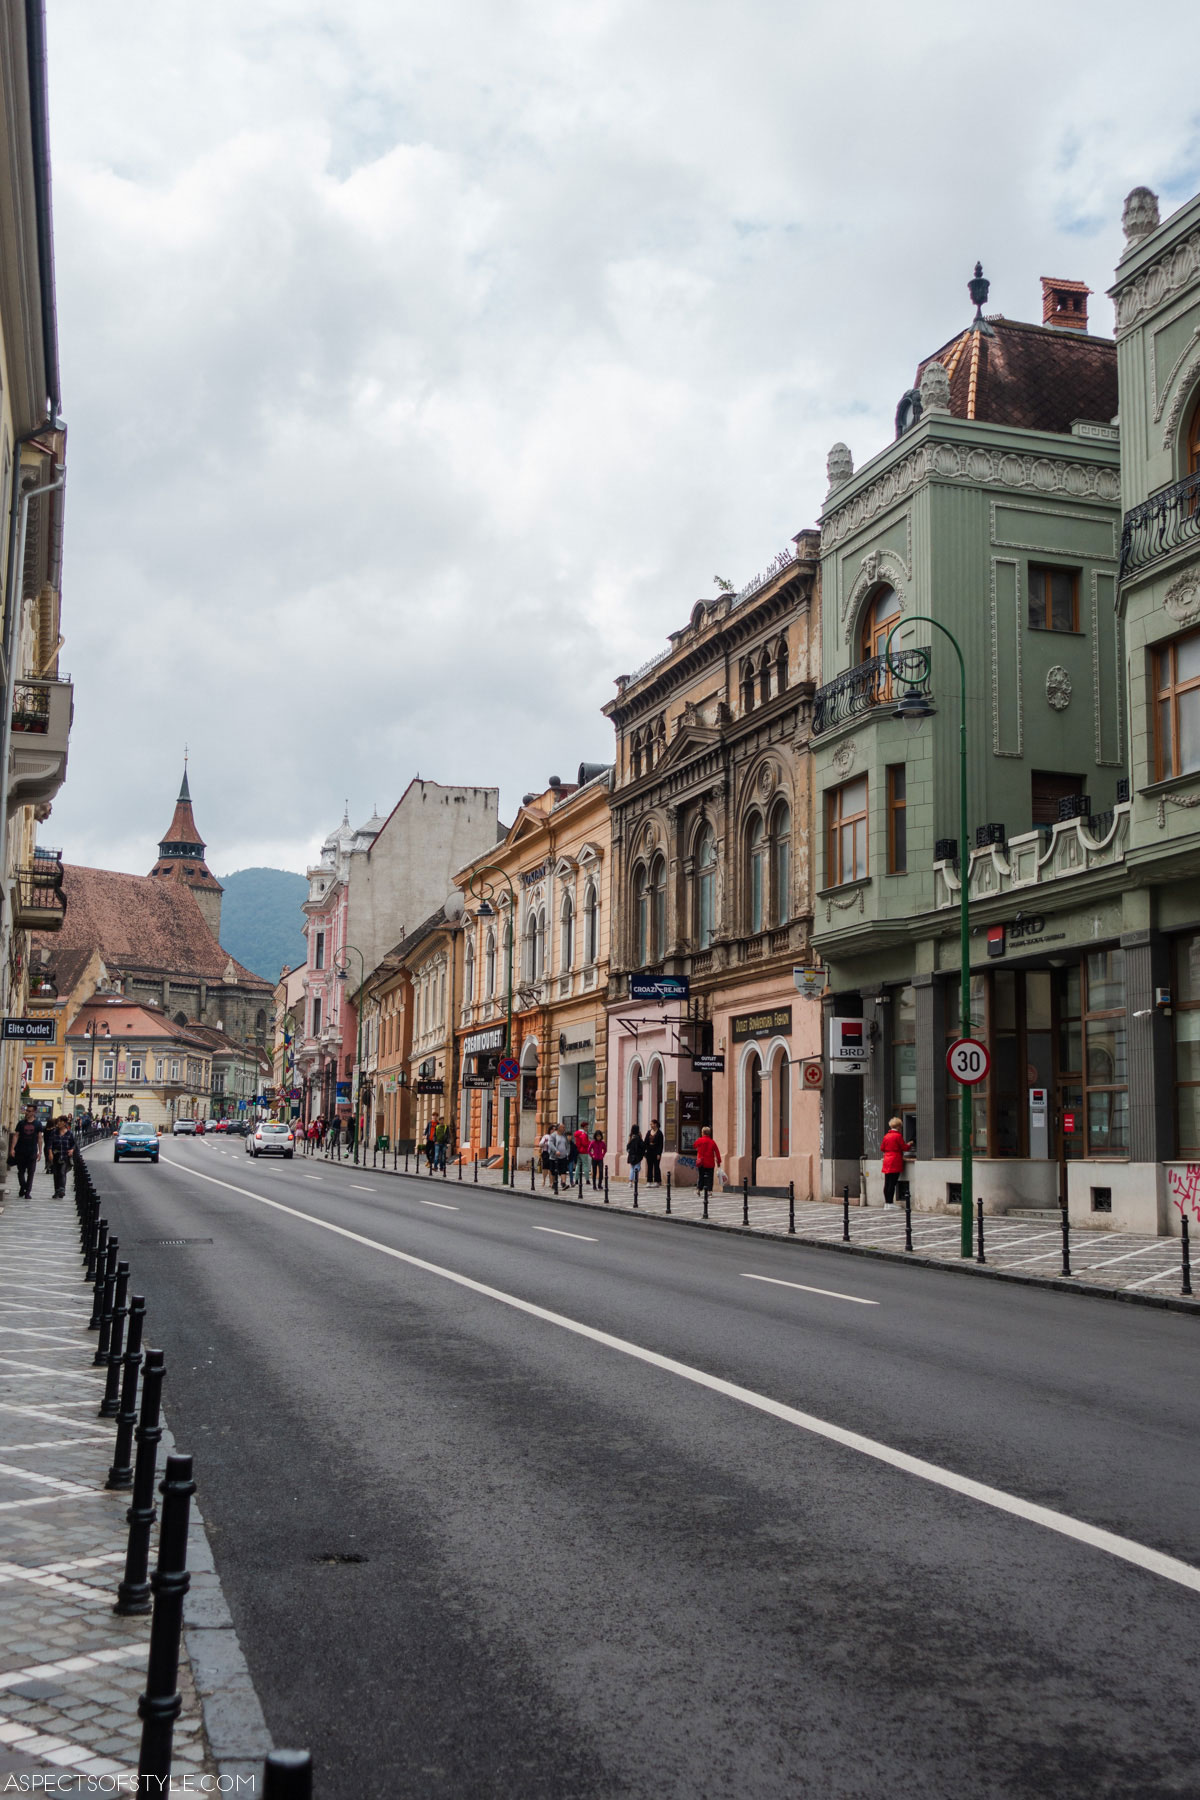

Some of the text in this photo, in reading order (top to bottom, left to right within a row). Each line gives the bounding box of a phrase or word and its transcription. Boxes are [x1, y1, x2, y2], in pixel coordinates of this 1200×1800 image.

[1009, 915, 1046, 938] BRD
[8, 1023, 50, 1035] Elite Outlet
[840, 1048, 865, 1056] BRD
[957, 1050, 980, 1073] 30
